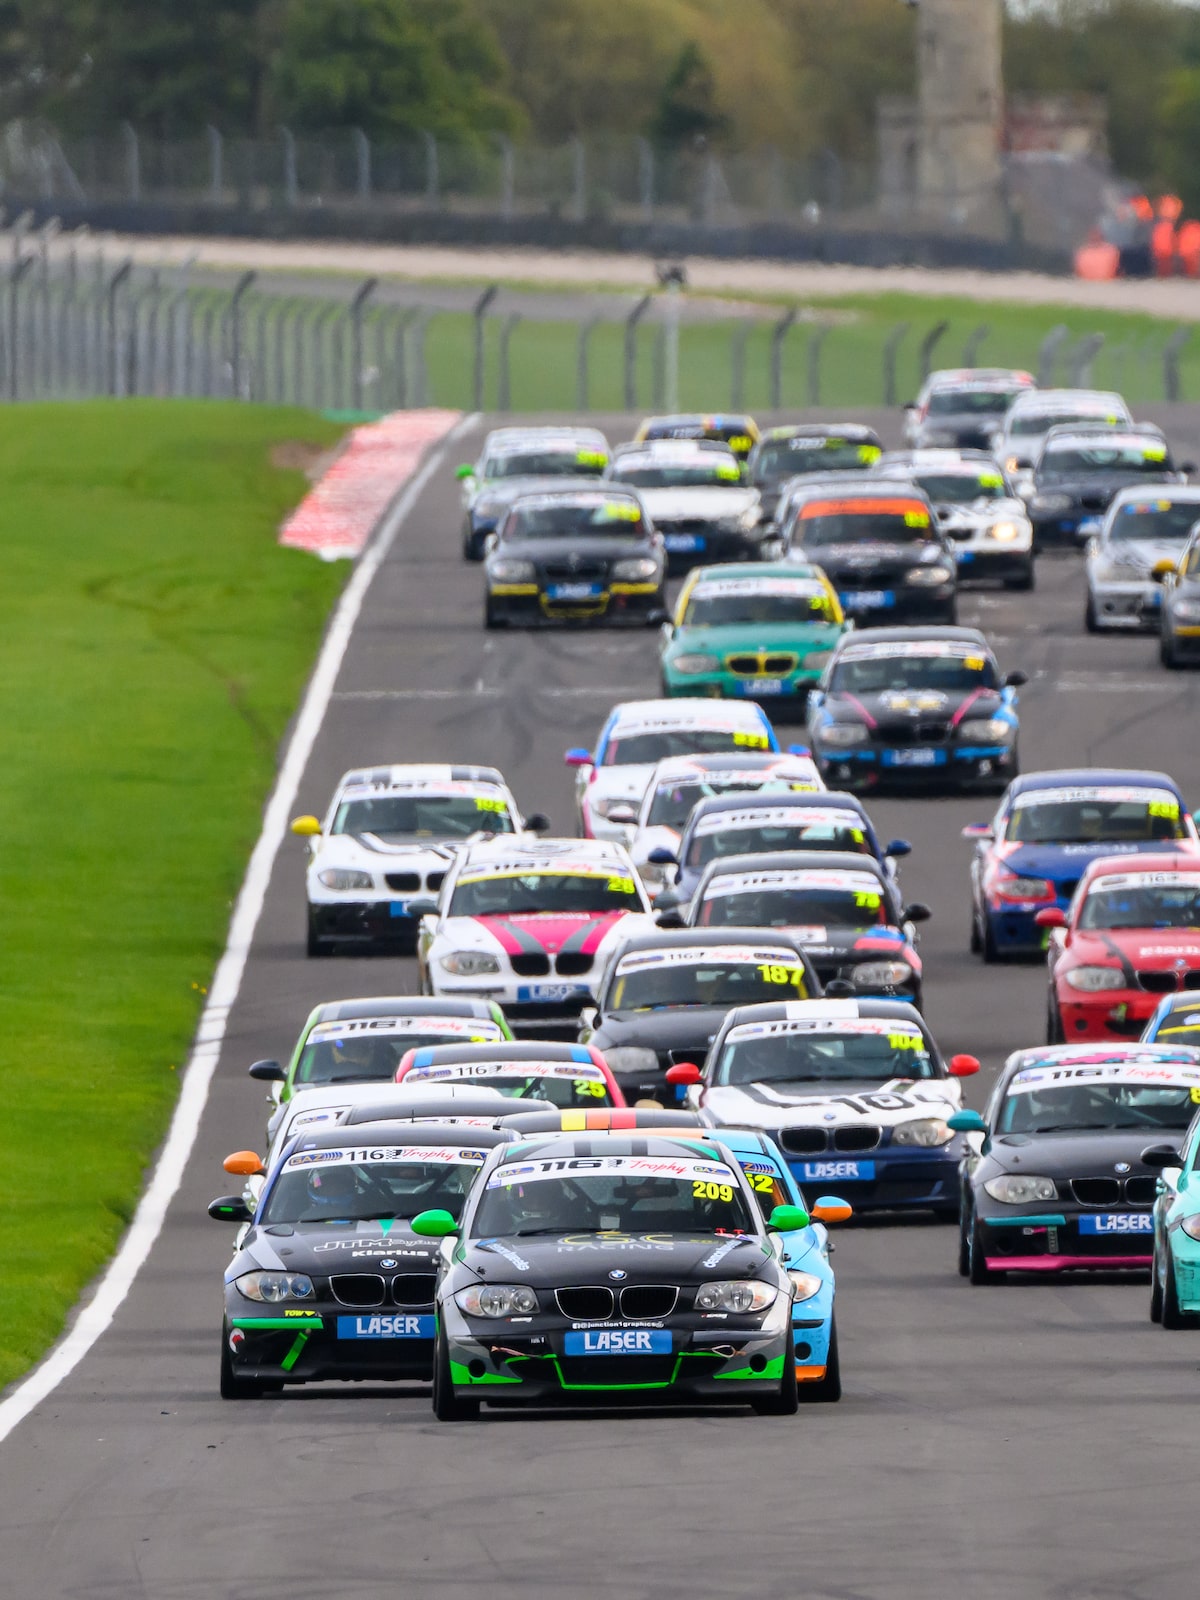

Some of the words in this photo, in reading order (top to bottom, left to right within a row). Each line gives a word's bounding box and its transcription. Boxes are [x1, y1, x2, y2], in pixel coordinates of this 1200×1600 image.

[757, 964, 805, 985] 187
[347, 1020, 397, 1031] 116
[455, 1065, 486, 1076] 116
[502, 1063, 549, 1076] Trophy
[1052, 1069, 1103, 1079] 116
[573, 1080, 606, 1098] 25
[347, 1150, 384, 1161] 116
[402, 1148, 456, 1161] Trophy
[540, 1159, 604, 1171] 116
[630, 1159, 688, 1175] Trophy
[805, 1162, 859, 1177] LASER
[693, 1181, 733, 1202] 209
[1096, 1214, 1152, 1230] LASER
[557, 1233, 675, 1246] CSC
[347, 1247, 416, 1255] Klarius
[557, 1243, 675, 1253] RACING
[356, 1317, 420, 1334] LASER
[584, 1331, 652, 1350] LASER
